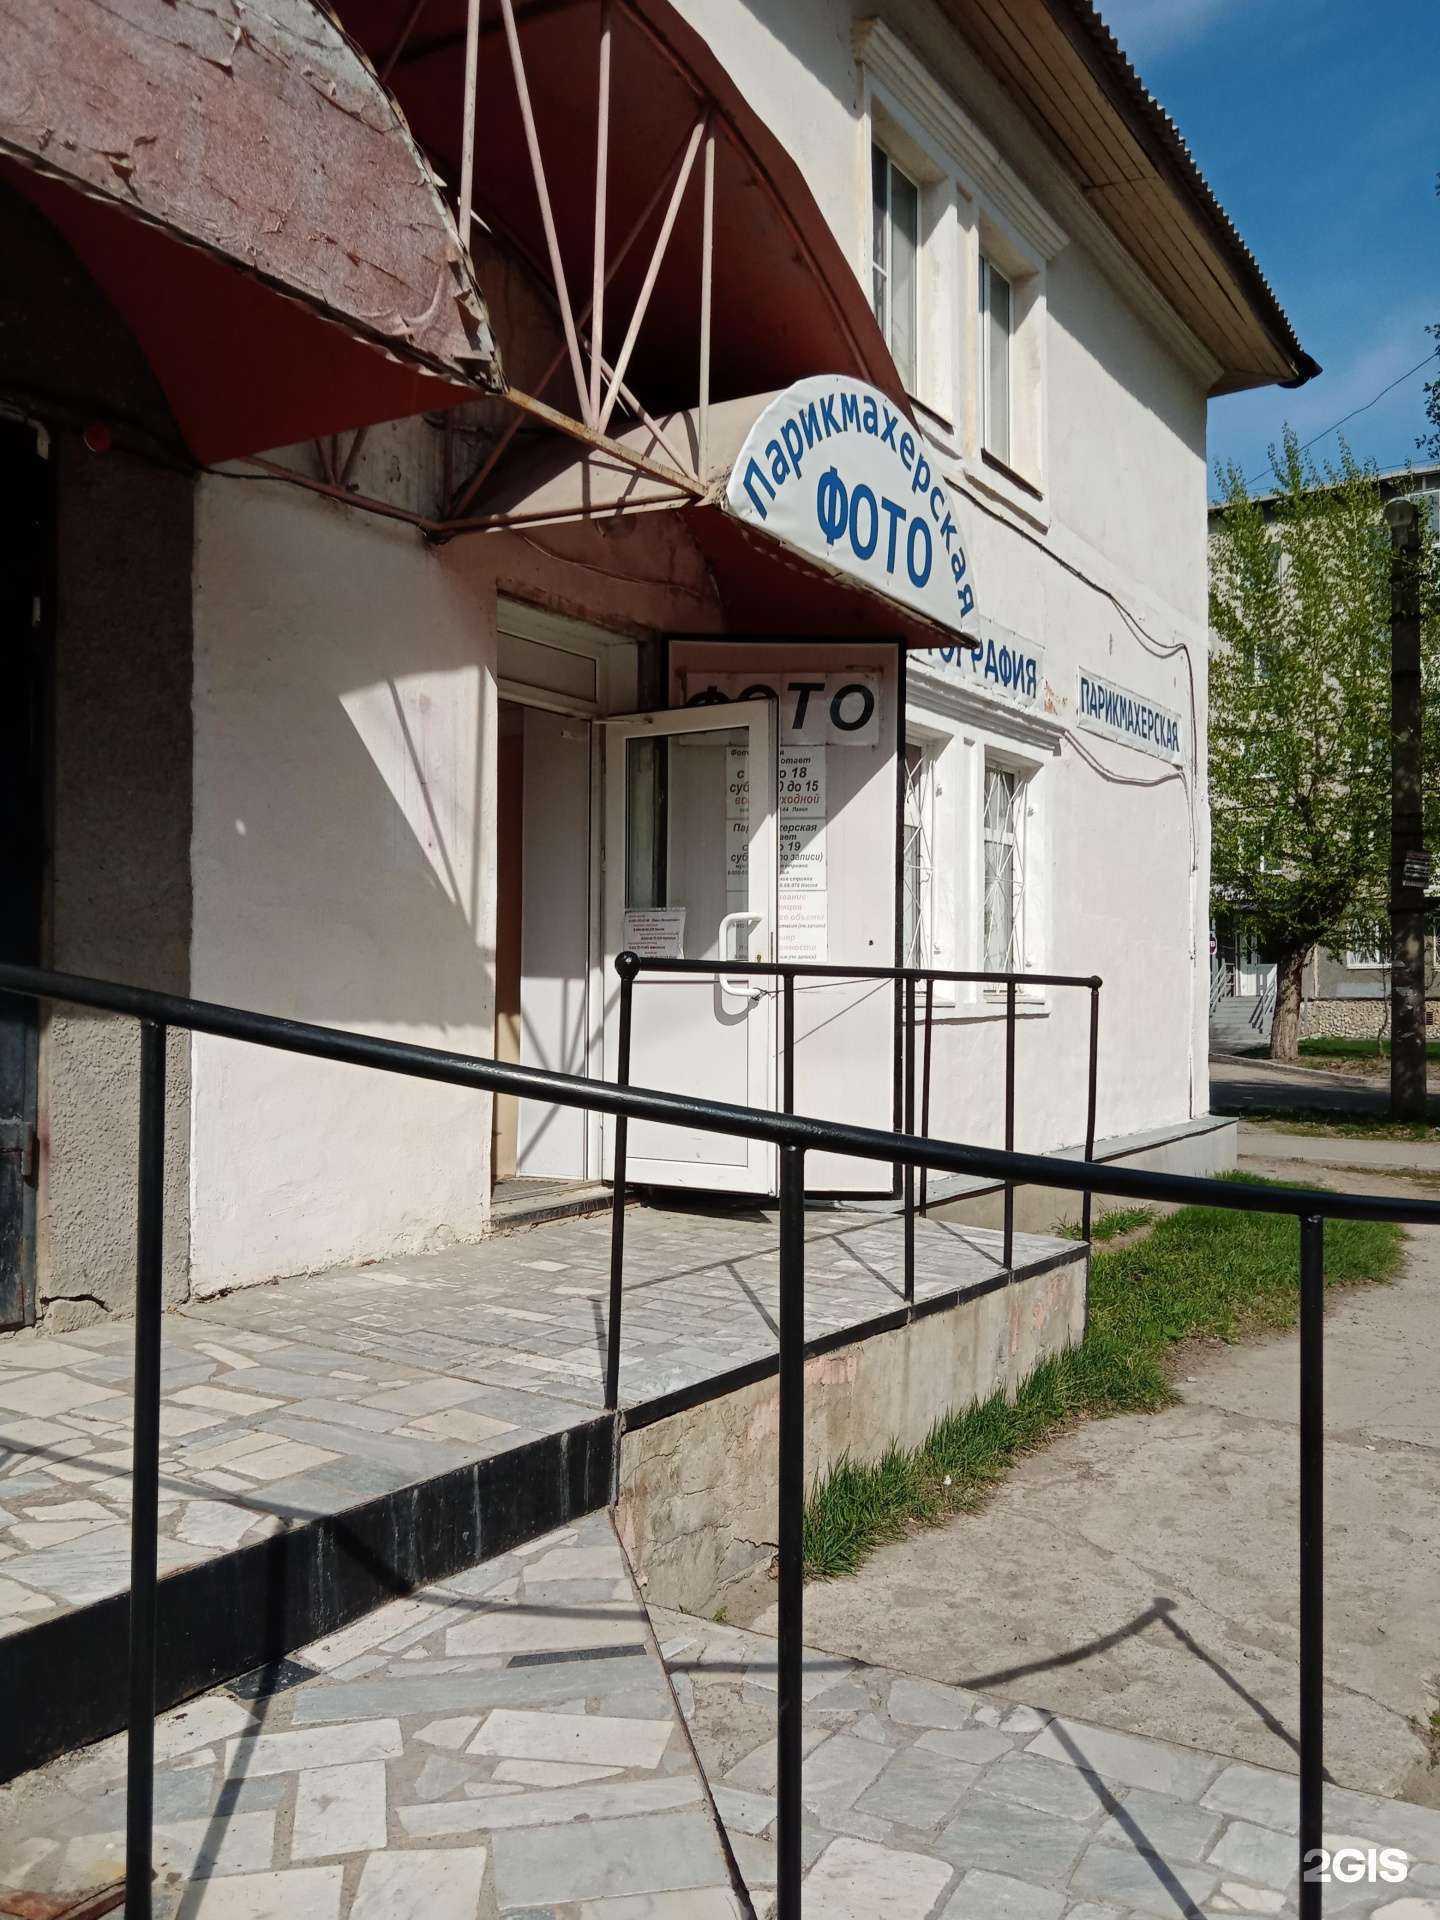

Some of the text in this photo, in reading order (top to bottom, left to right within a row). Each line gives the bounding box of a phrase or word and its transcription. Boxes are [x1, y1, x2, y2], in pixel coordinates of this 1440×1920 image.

[743, 392, 975, 618] Парикмахерская
[816, 465, 933, 588] ФОТО
[1080, 678, 1180, 752] ПАРИКМАХЕРСКАЯ
[787, 780, 802, 793] до
[805, 780, 819, 793] 15
[791, 767, 808, 779] 18
[788, 841, 801, 852] 19
